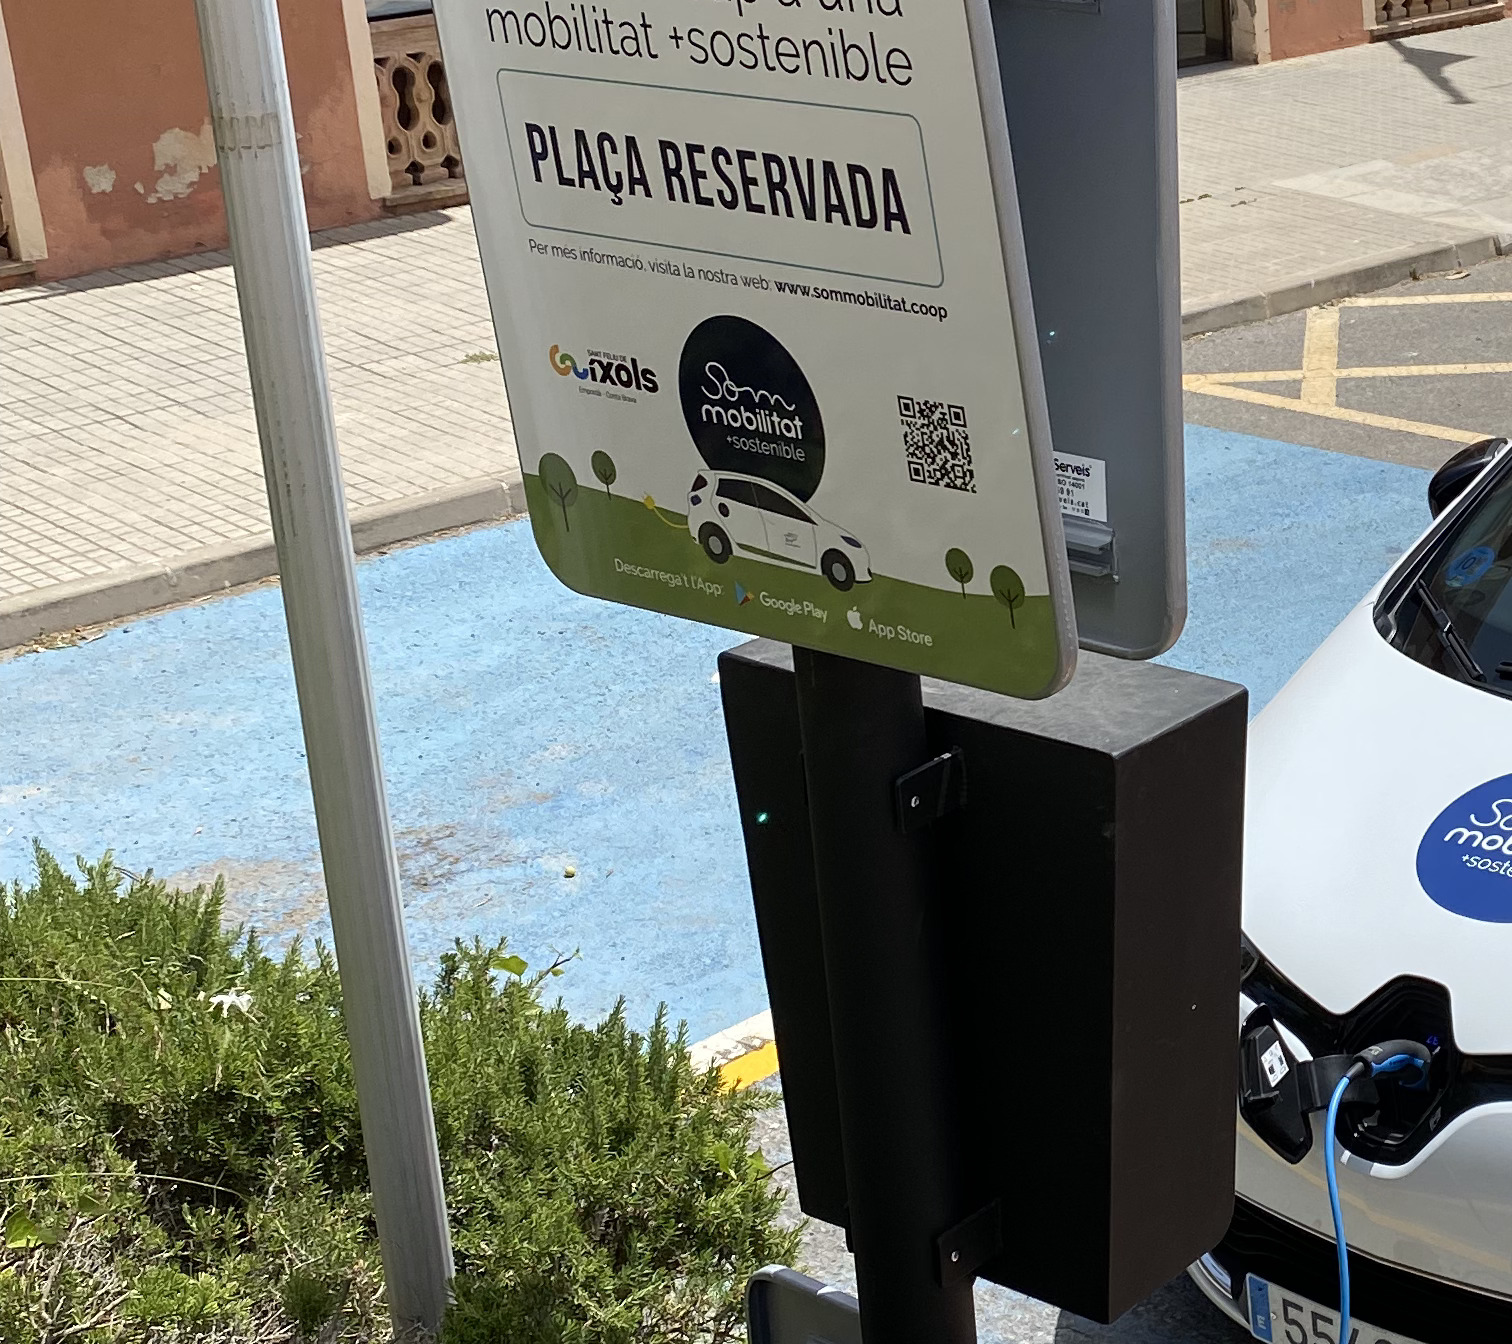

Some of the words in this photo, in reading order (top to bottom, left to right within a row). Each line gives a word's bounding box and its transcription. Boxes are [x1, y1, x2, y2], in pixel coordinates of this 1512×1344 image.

[485, 1, 659, 59] mobilitat
[669, 23, 913, 86] +sostenible
[524, 121, 653, 206] PLAÇA
[658, 138, 912, 235] RESERVADA
[528, 238, 549, 255] Per
[551, 243, 578, 261] més
[648, 257, 681, 277] visita
[683, 262, 695, 279] la
[697, 268, 739, 286] nostra
[740, 273, 772, 292] web:
[773, 279, 948, 322] www.sommobilitat.coop
[701, 361, 796, 411] Som
[701, 404, 803, 440] mobilitat
[726, 435, 806, 462] +sostenible
[759, 591, 803, 617] Google
[803, 601, 828, 623] Play
[868, 618, 895, 640] App
[897, 625, 933, 647] Store
